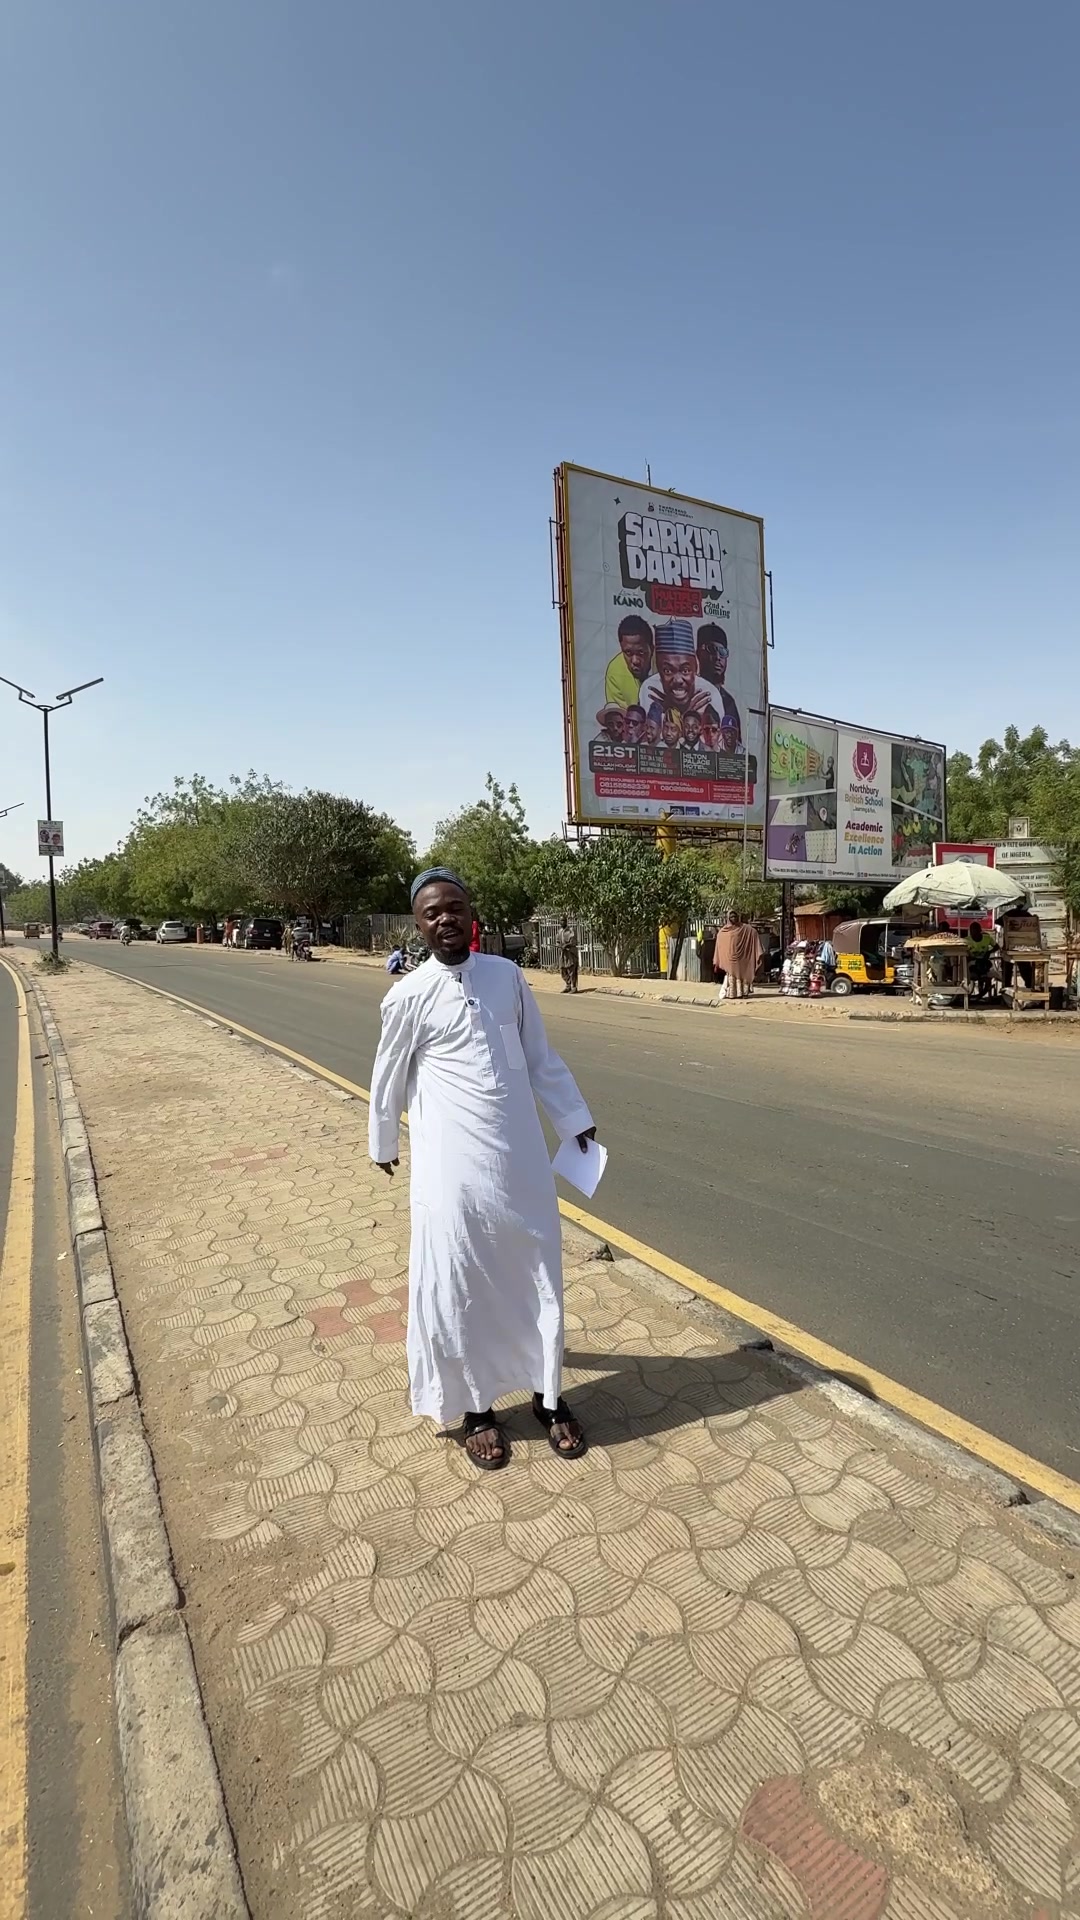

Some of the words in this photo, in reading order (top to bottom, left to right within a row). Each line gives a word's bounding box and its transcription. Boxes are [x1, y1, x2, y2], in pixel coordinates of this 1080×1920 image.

[613, 594, 644, 608] KANO
[593, 744, 636, 759] 21ST
[682, 752, 708, 760] HILTON
[850, 783, 879, 797] Northbury
[844, 793, 864, 804] British
[864, 796, 884, 807] School
[845, 820, 883, 832] Academic
[844, 831, 885, 844] Excellence
[857, 845, 883, 856] Action
